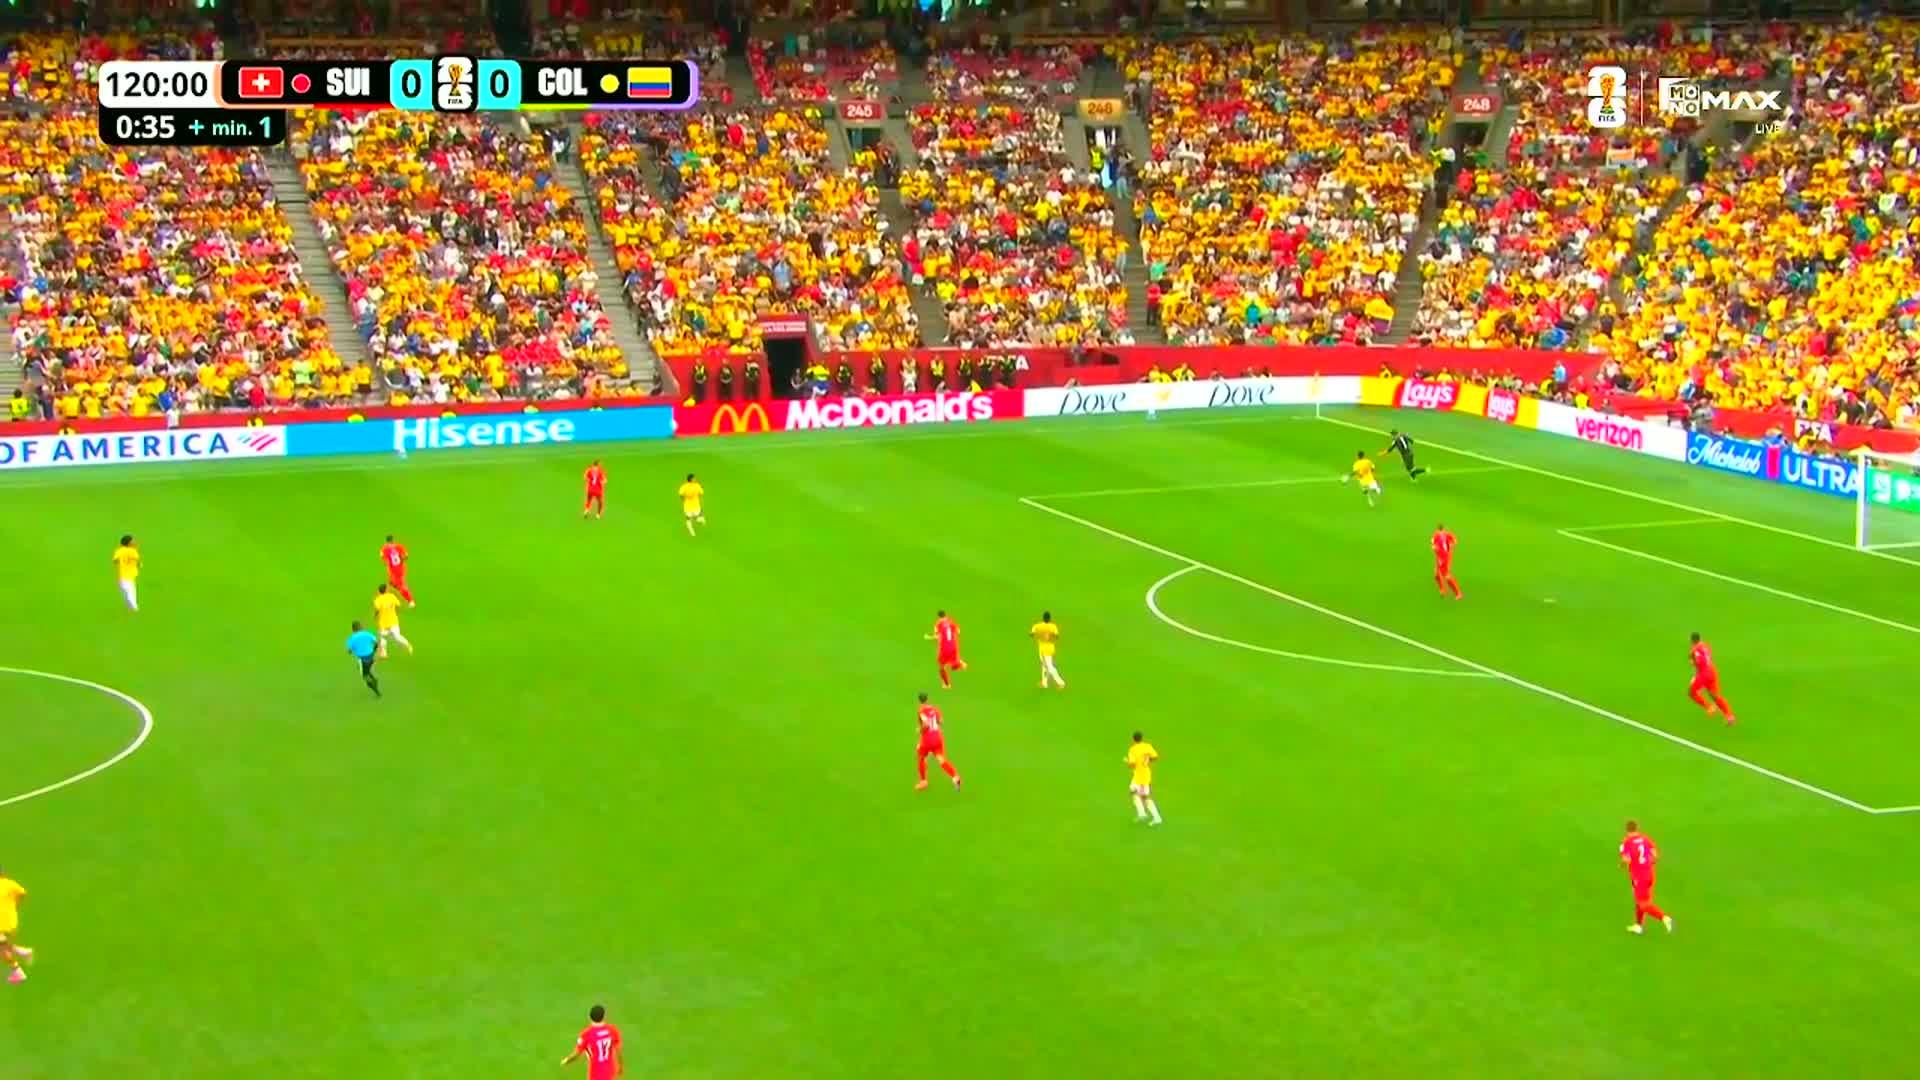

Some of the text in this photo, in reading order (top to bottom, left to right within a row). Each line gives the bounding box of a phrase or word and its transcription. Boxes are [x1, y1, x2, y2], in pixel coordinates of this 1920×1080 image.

[1058, 388, 1127, 415] Dove
[1208, 381, 1275, 408] Dove
[785, 392, 993, 431] McDonald's
[53, 432, 229, 461] AMERICA
[393, 417, 576, 449] Hisense
[1575, 415, 1643, 450] verizon
[1687, 434, 1762, 475] Michelob
[1783, 454, 1858, 495] ULTRA
[596, 1038, 612, 1062] 17
